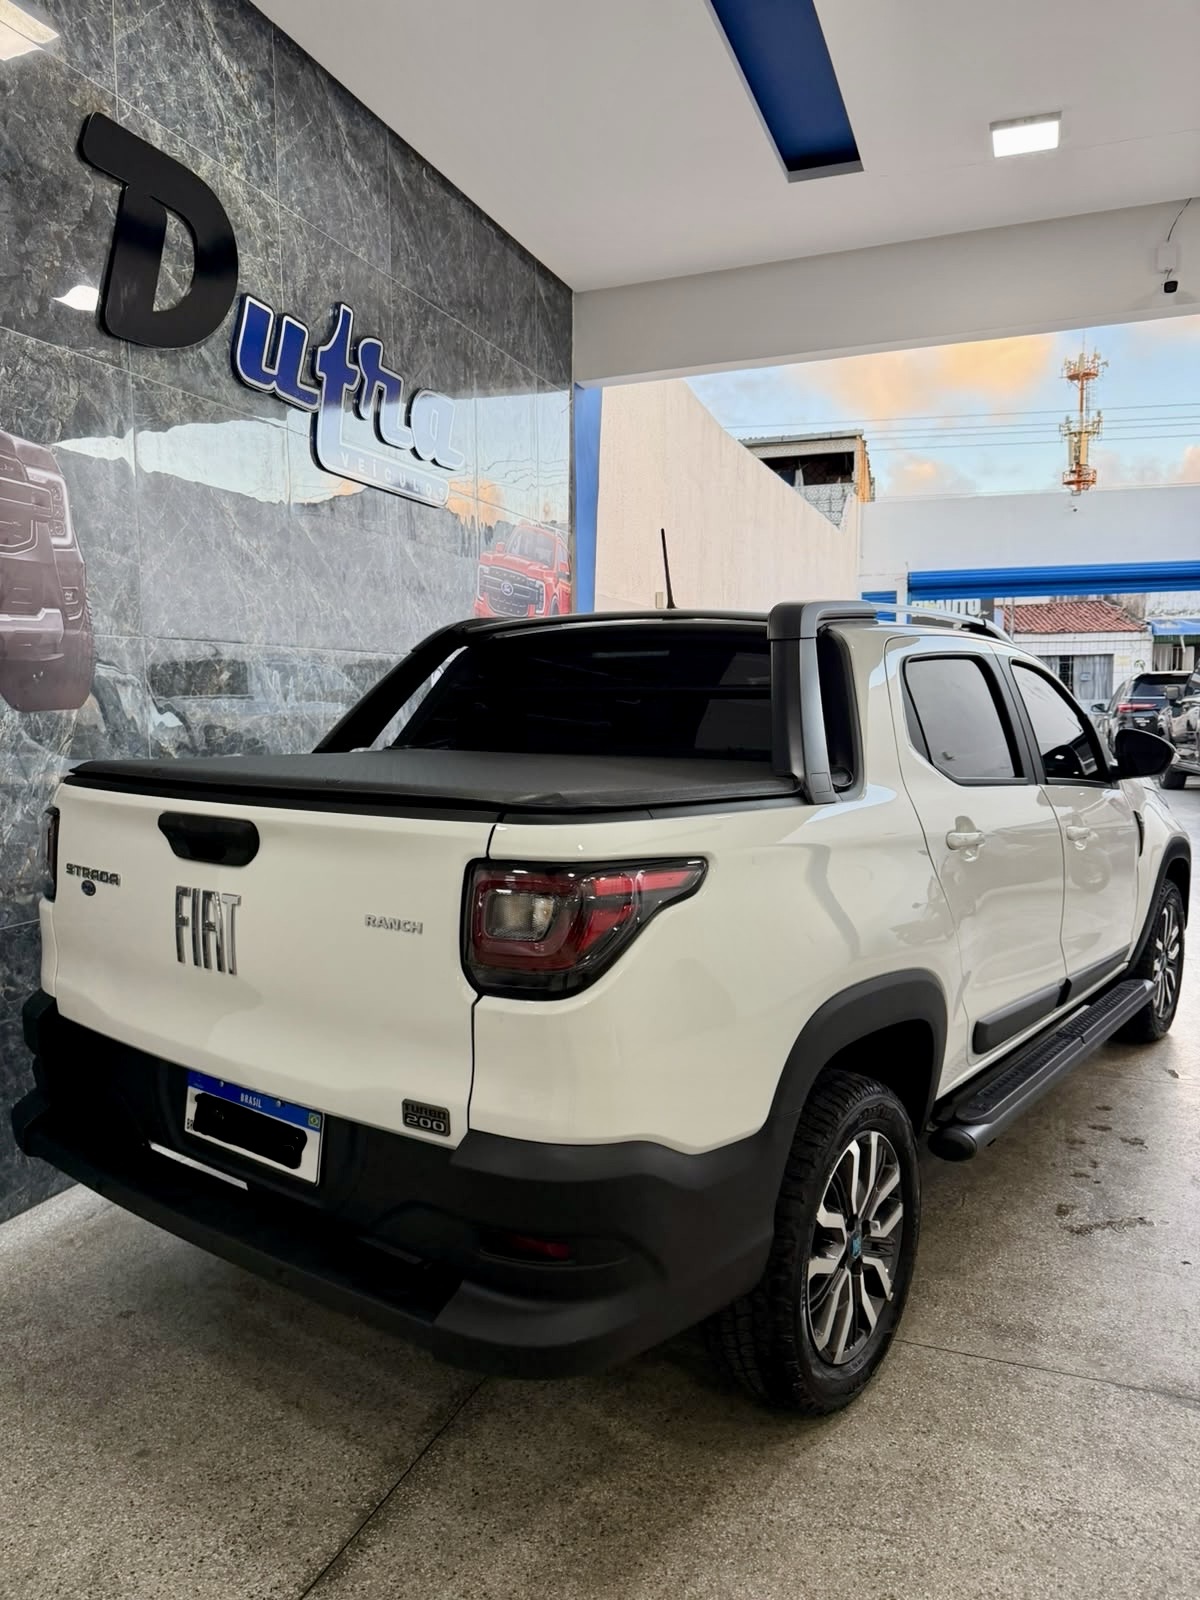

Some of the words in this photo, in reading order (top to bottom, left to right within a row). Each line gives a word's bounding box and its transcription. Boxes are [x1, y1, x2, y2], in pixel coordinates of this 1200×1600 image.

[76, 111, 465, 472] Dutra
[65, 862, 121, 887] STRADA
[175, 885, 242, 976] FIAT
[364, 913, 424, 935] RANCH
[240, 1092, 263, 1109] BRASIL
[406, 1113, 445, 1132] 200
